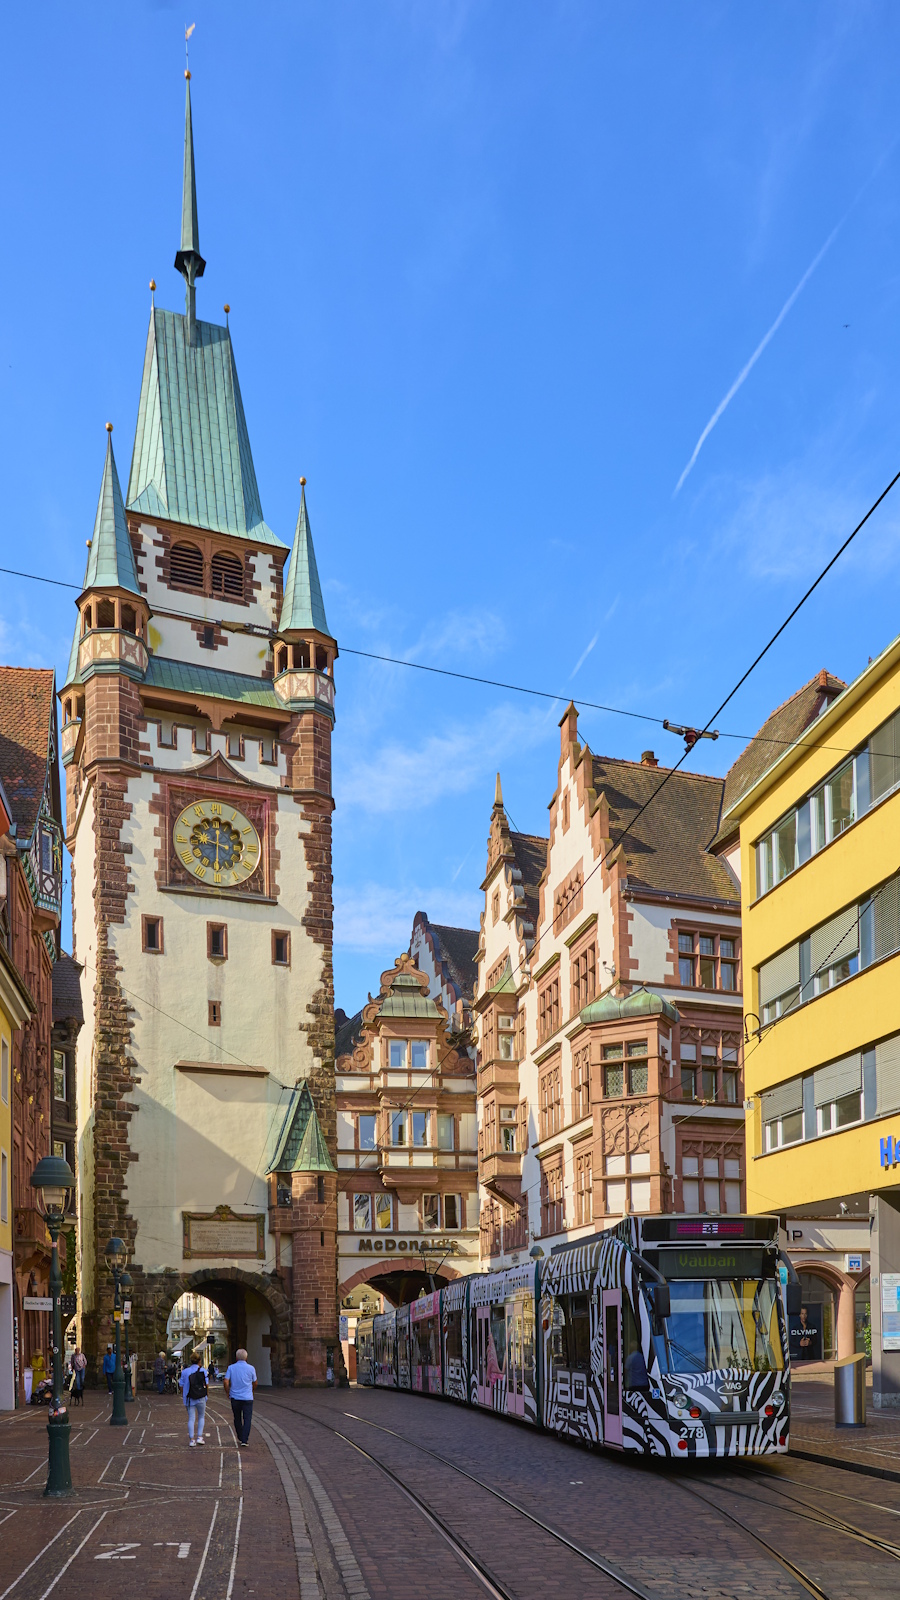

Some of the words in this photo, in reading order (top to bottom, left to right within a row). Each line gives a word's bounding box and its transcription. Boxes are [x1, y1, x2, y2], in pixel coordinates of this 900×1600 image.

[358, 1239, 459, 1252] McDonald's
[679, 1253, 736, 1267] Vauban
[725, 1382, 742, 1390] VAG
[557, 1406, 588, 1425] SCHUHE
[680, 1427, 704, 1439] 278
